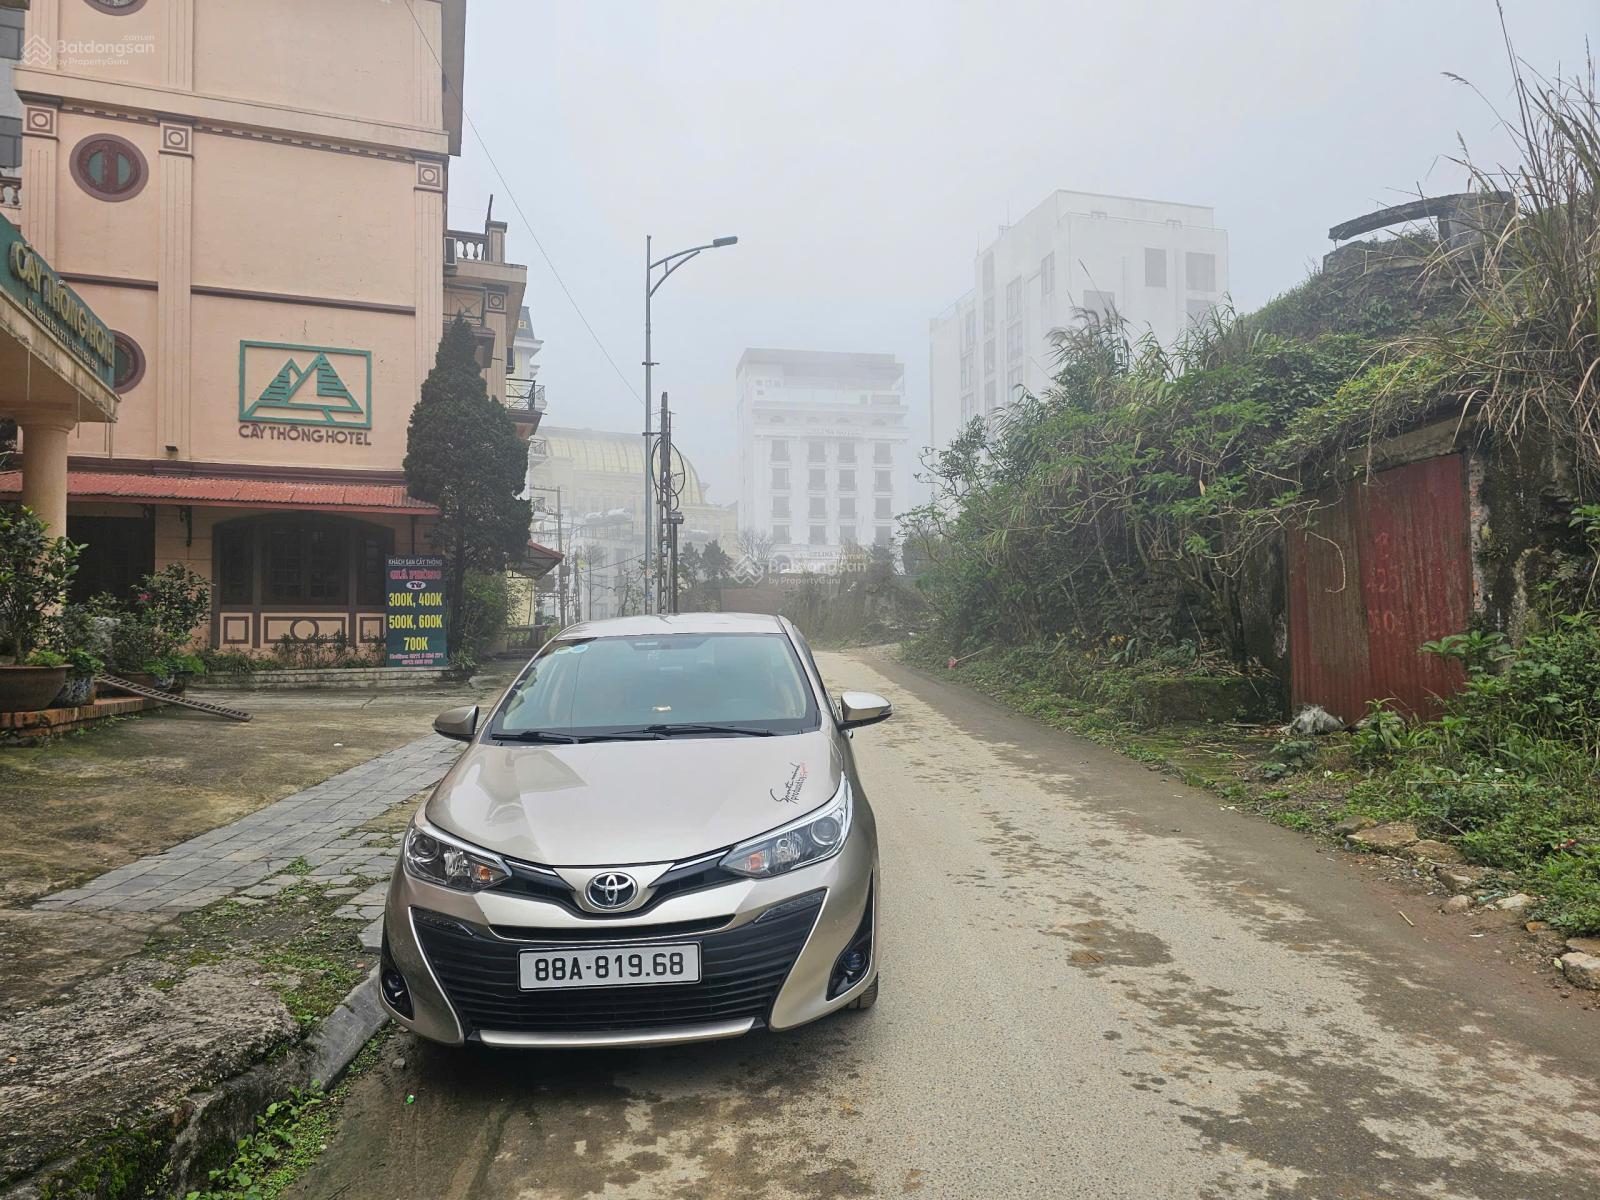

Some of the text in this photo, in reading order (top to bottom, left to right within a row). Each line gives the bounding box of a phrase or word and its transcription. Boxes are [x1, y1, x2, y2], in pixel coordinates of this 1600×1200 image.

[238, 424, 372, 446] CÂY THÔNG HOTEL
[388, 592, 443, 608] 300K, 400K
[388, 614, 443, 630] 500K, 600K
[404, 637, 429, 651] 700K
[534, 952, 684, 982] 88A-819.68
